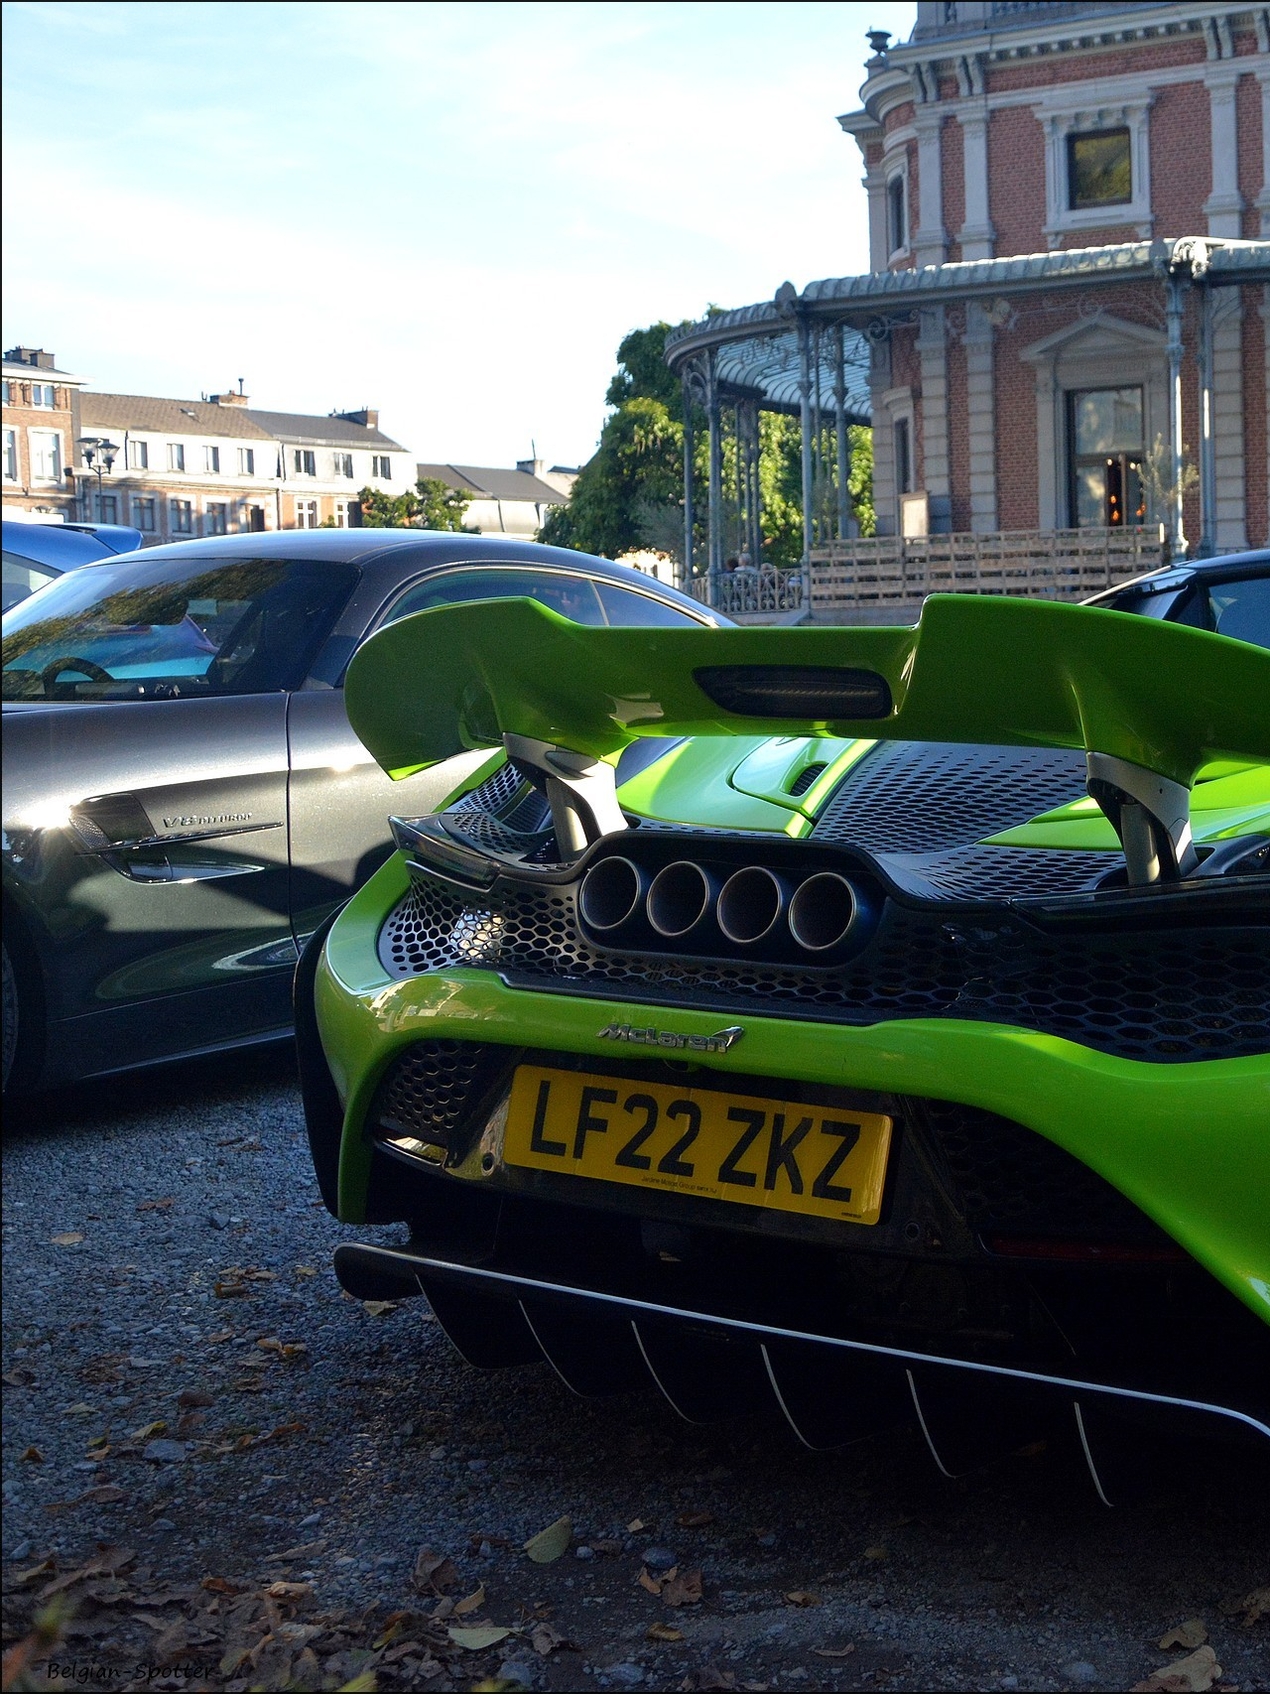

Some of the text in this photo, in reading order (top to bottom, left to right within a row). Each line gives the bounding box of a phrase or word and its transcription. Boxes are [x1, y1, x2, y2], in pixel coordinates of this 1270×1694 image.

[162, 815, 197, 828] V8
[597, 1023, 742, 1053] McLaren
[530, 1080, 861, 1203] LF22 ZKZ
